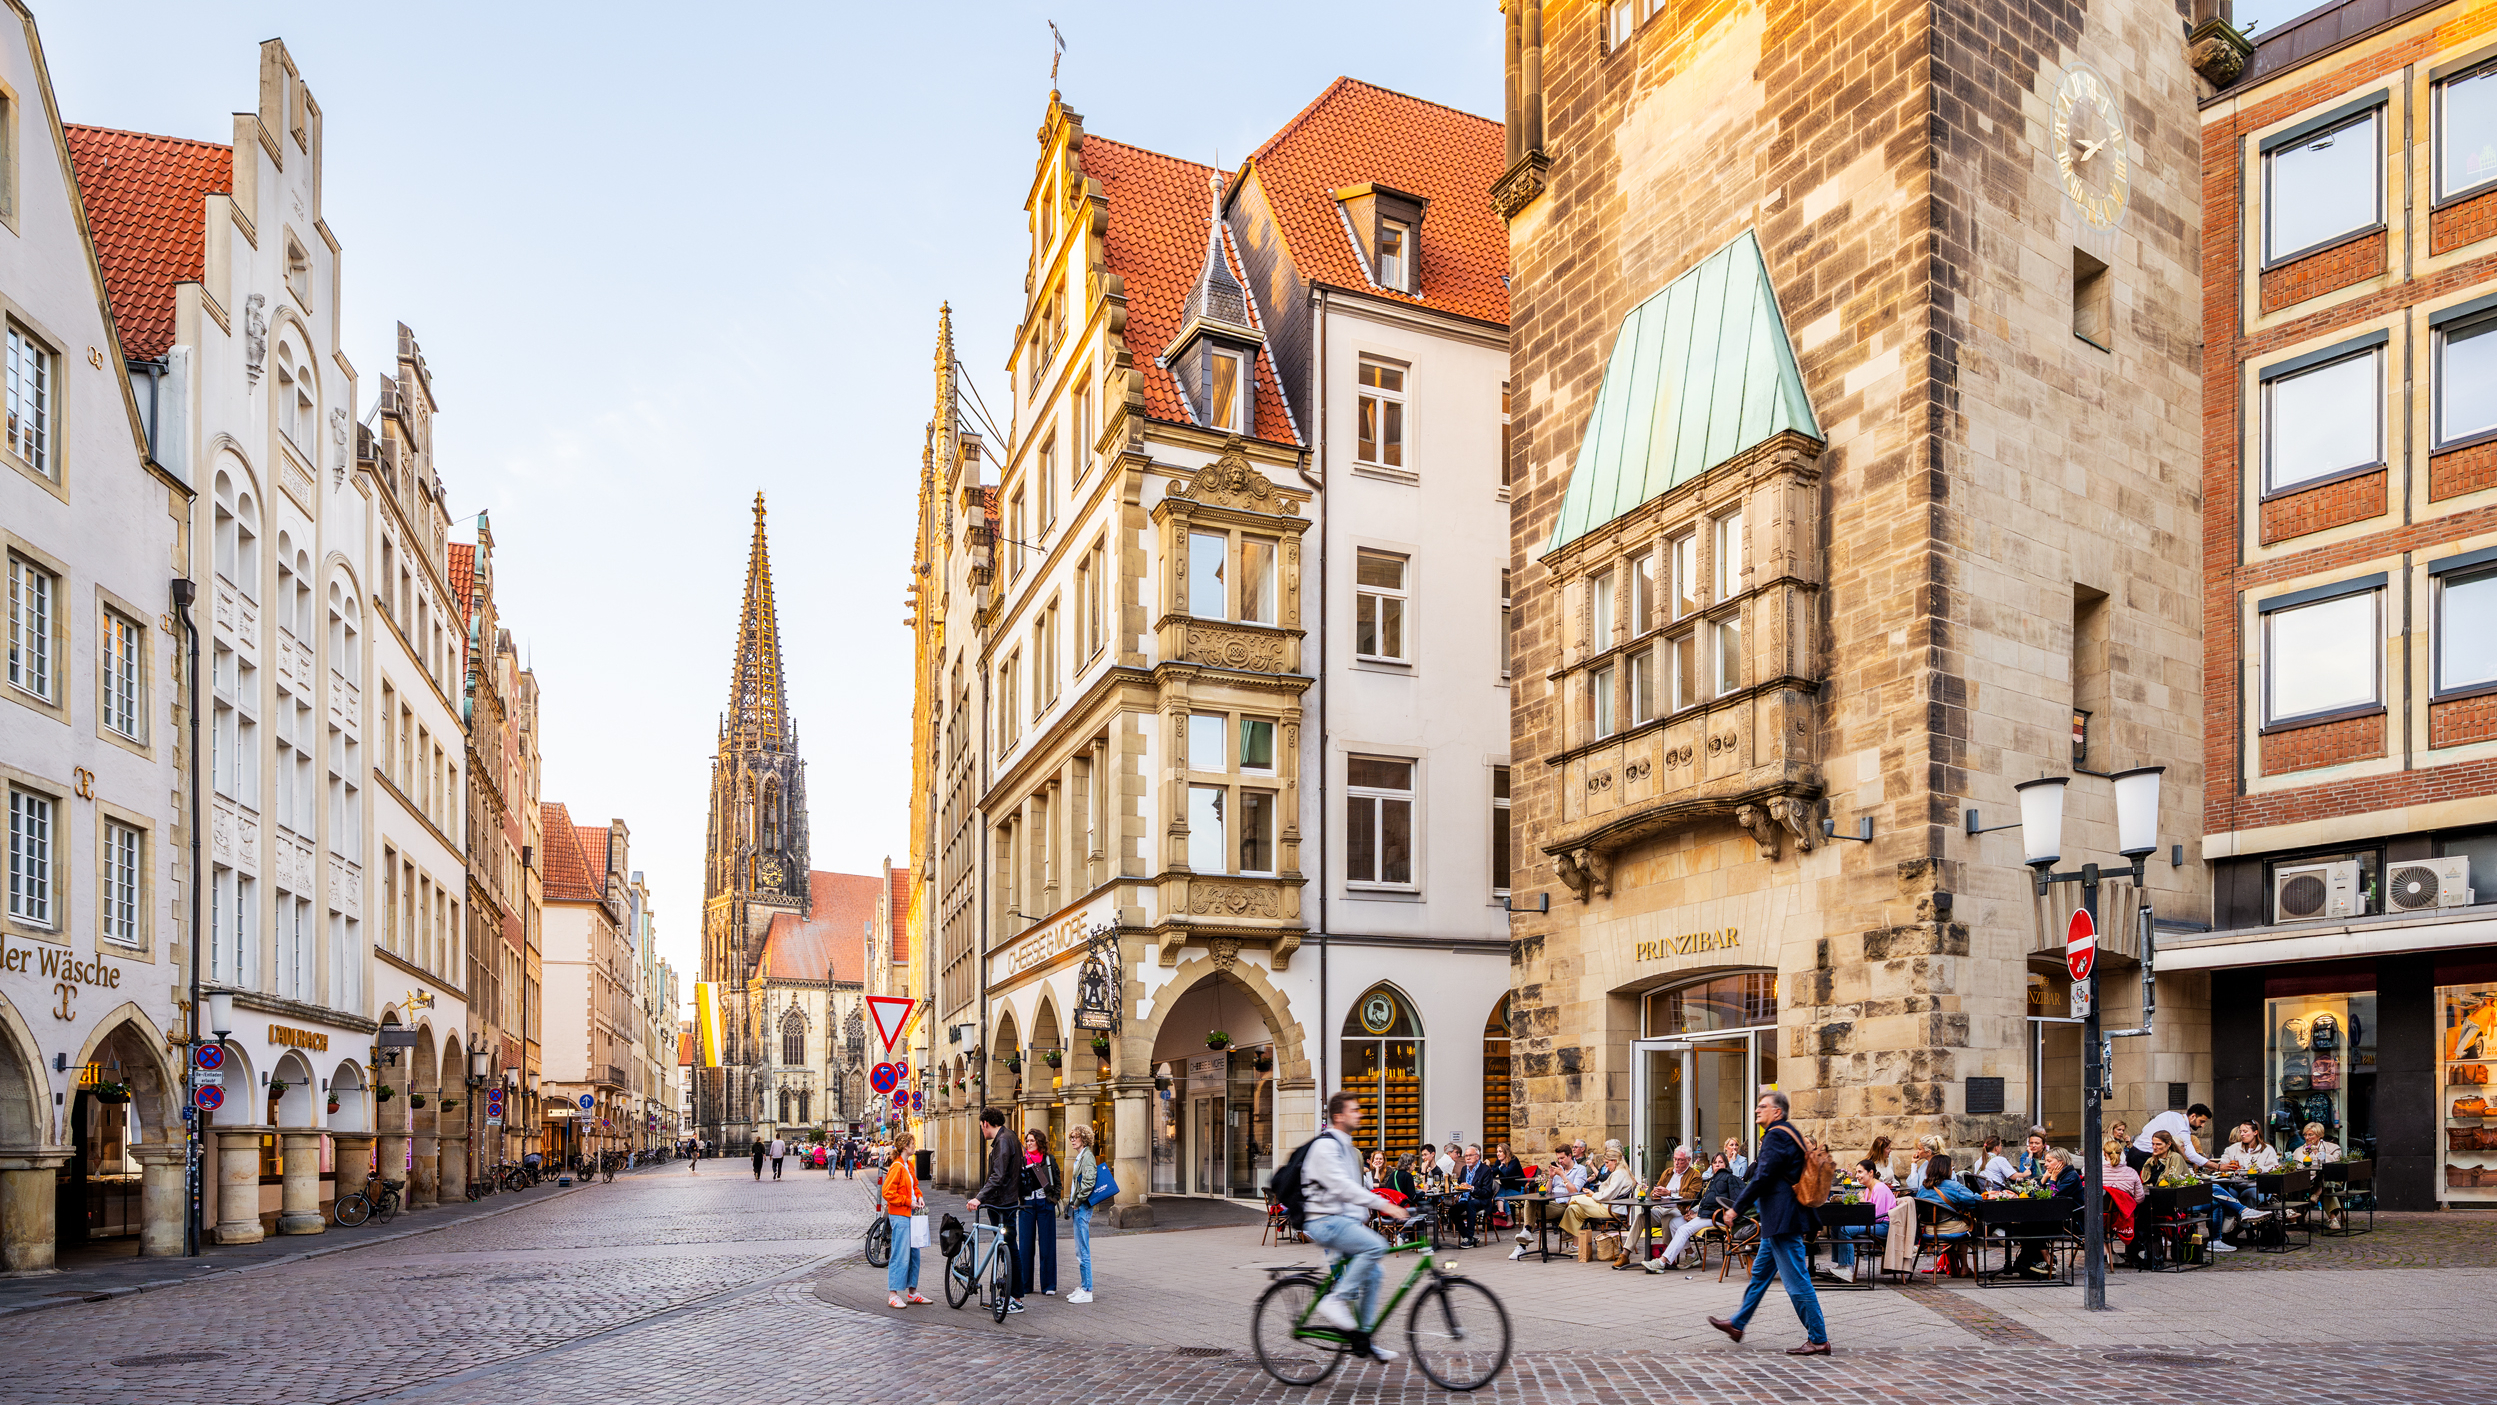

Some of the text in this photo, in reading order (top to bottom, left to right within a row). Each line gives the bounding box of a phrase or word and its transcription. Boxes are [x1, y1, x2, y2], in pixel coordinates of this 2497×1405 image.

[1008, 933, 1046, 975] CHEESE
[1054, 910, 1088, 952] MORE
[1635, 926, 1740, 962] PRINZIBAR
[37, 946, 120, 989] Wäsche
